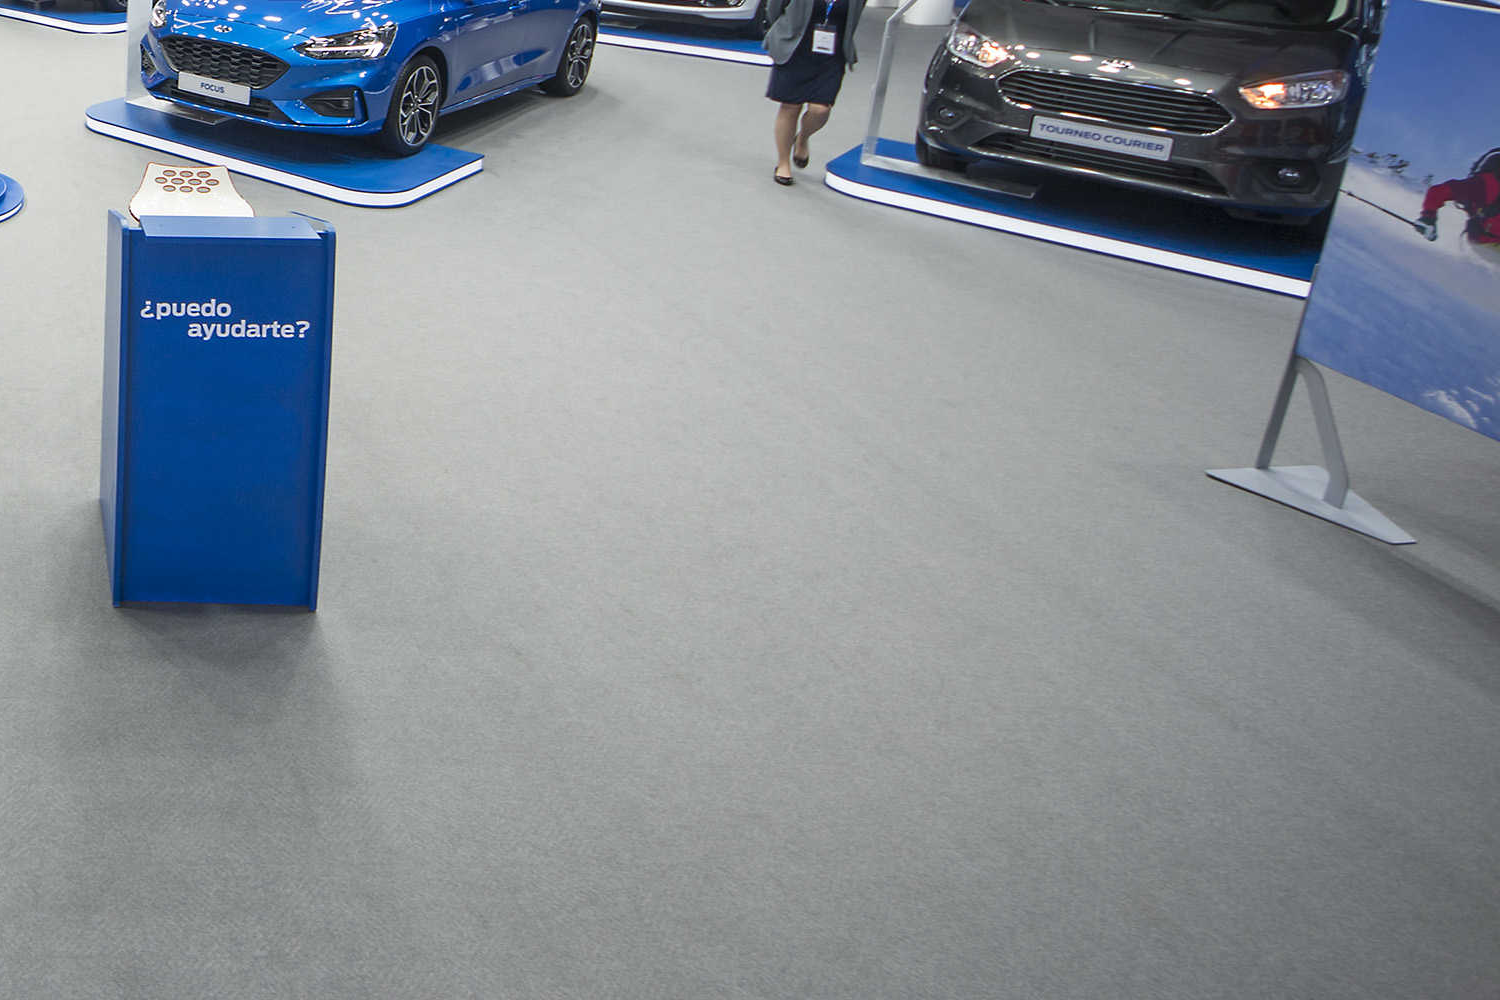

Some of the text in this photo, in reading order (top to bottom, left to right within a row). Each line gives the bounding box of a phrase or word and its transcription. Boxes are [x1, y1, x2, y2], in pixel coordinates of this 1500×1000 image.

[200, 82, 225, 94] FOCUS
[1039, 123, 1165, 153] TOURNEO COURIER
[140, 298, 232, 320] ¿puedo
[187, 319, 311, 341] ayudarte?
